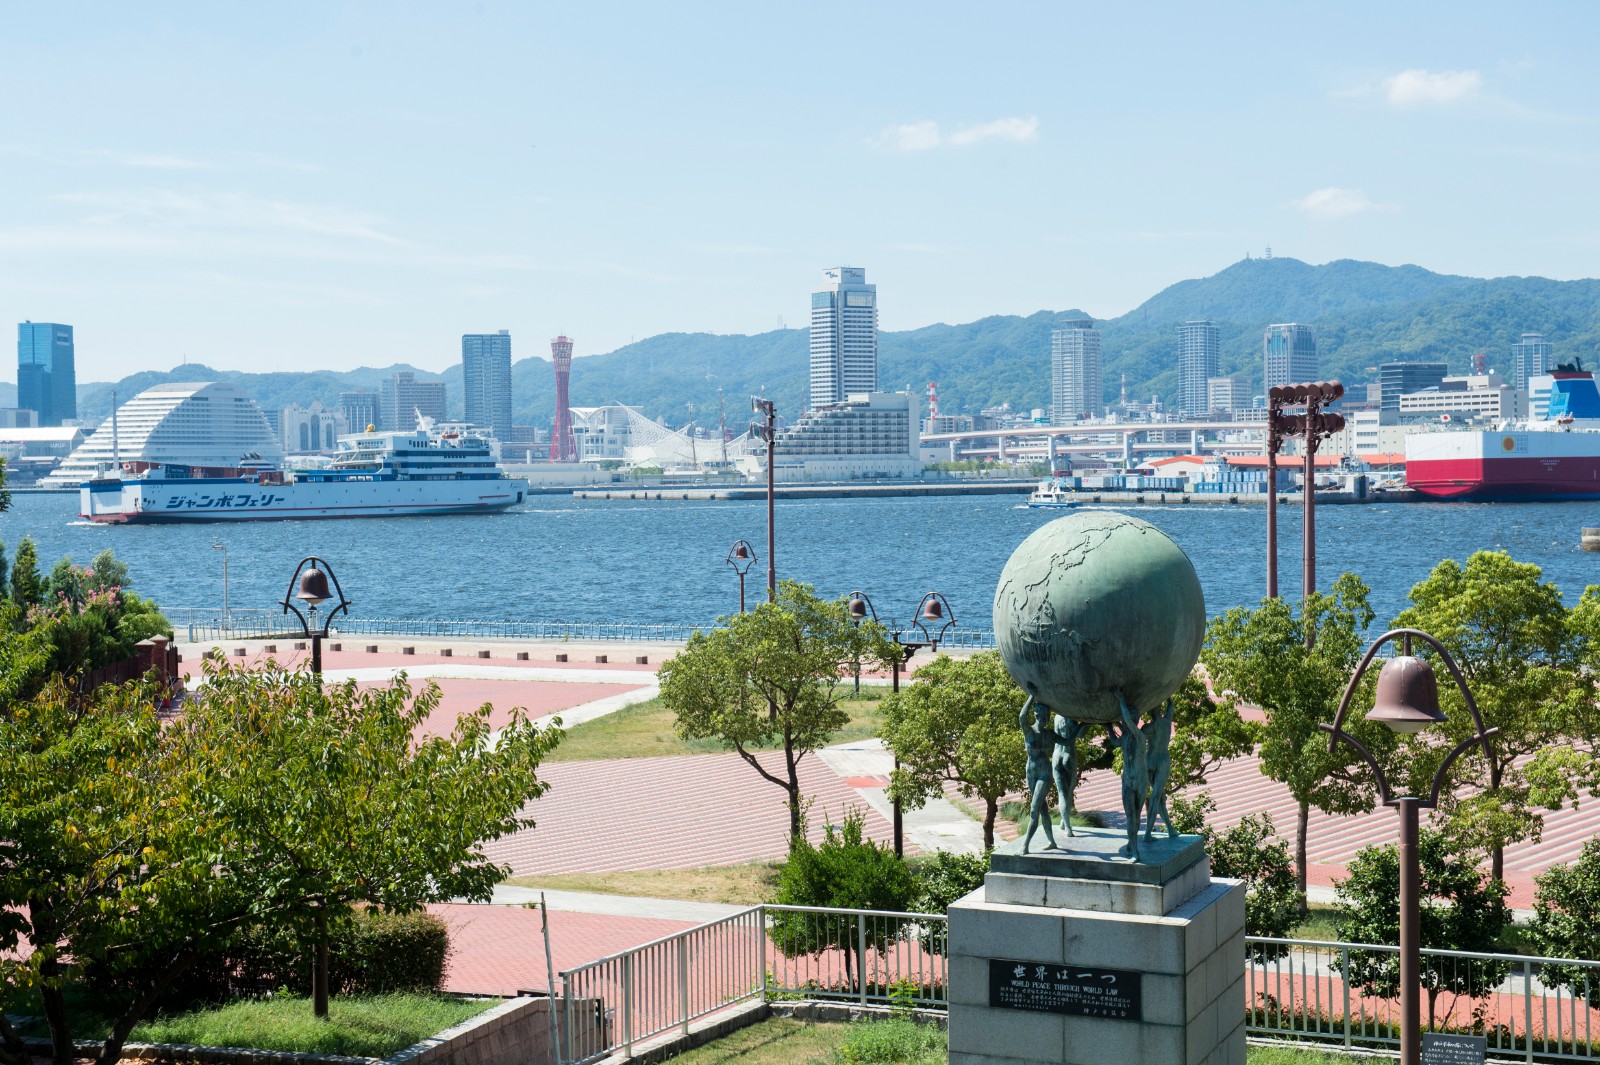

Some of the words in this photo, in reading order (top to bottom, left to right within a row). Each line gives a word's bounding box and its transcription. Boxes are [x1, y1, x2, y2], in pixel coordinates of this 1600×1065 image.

[166, 494, 285, 509] ジャンボフェリー
[1013, 964, 1117, 984] 世界は一つ
[1010, 979, 1030, 988] WORLD
[1032, 981, 1050, 990] PEACE
[1054, 983, 1080, 992] THROUGH
[1083, 985, 1102, 995] WORLD
[1106, 988, 1119, 996] LAW
